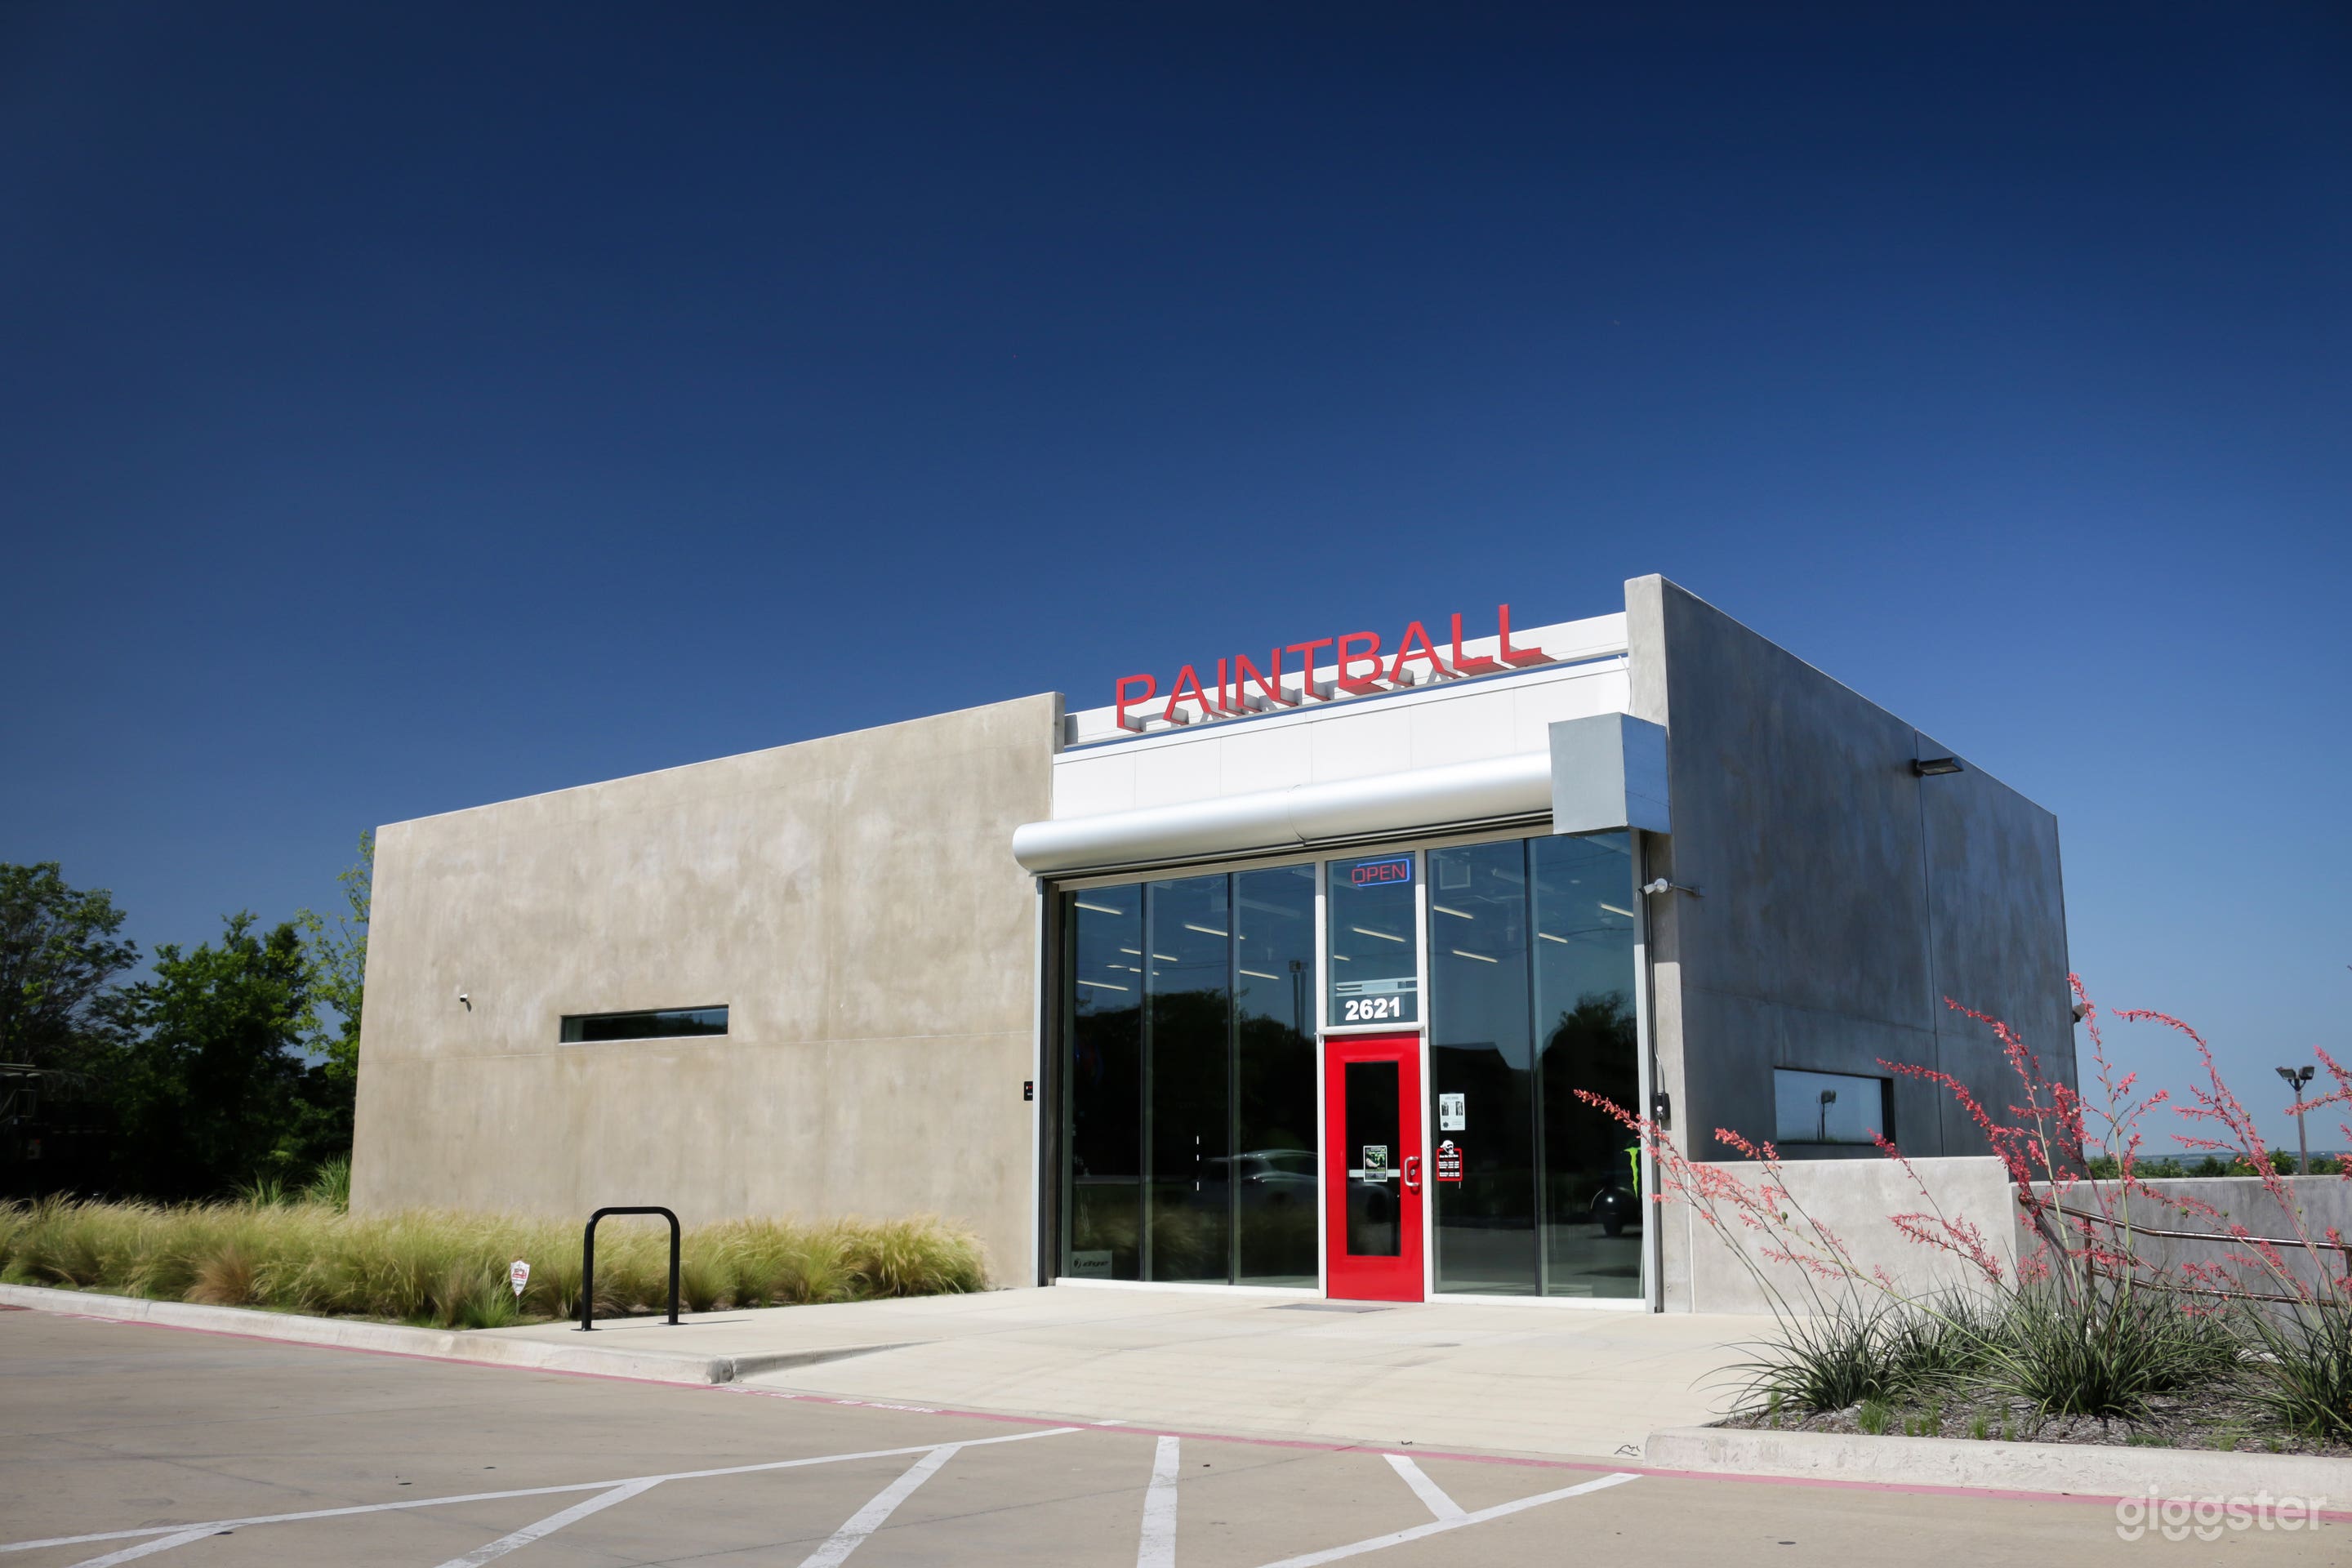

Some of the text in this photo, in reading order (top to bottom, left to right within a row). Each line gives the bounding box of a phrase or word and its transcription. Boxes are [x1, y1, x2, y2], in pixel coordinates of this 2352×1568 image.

[1116, 604, 1542, 733] PAINTBALL
[1352, 863, 1405, 884] OPEN
[1345, 996, 1401, 1020] 2621
